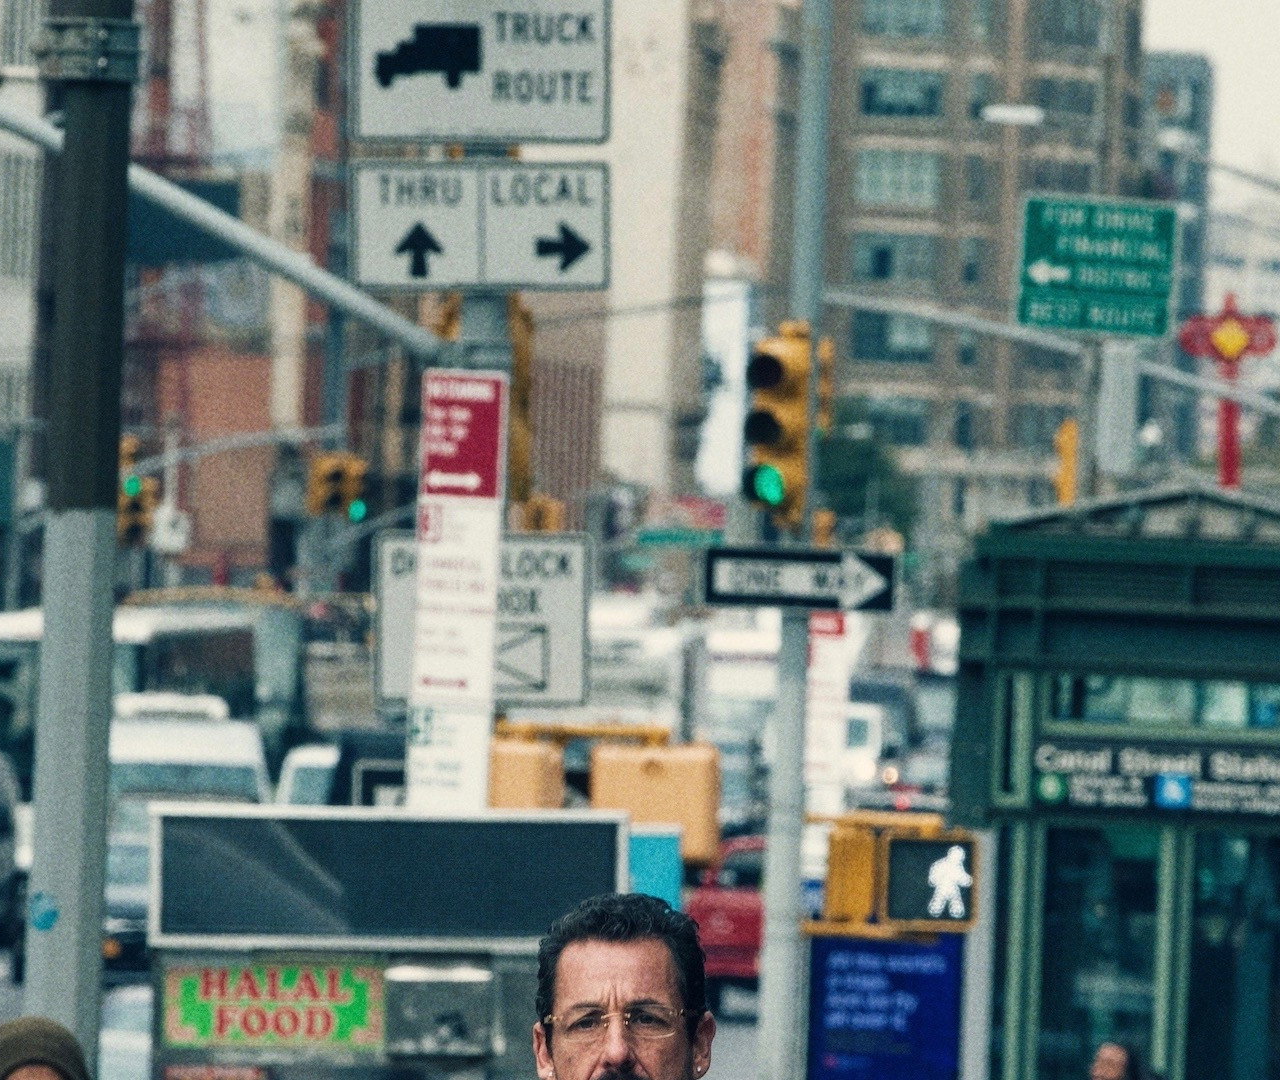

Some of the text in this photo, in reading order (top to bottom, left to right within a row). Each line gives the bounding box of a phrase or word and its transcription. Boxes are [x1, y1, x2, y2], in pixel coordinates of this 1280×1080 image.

[493, 11, 596, 44] TRUCK
[491, 70, 595, 103] ROUTE
[378, 174, 464, 207] THRU
[491, 174, 594, 208] LOCAL
[499, 551, 574, 579] LOCK
[1035, 743, 1112, 772] Canal
[1120, 746, 1202, 776] Street
[200, 968, 355, 1004] HALAL
[214, 1003, 335, 1038] FOOD
